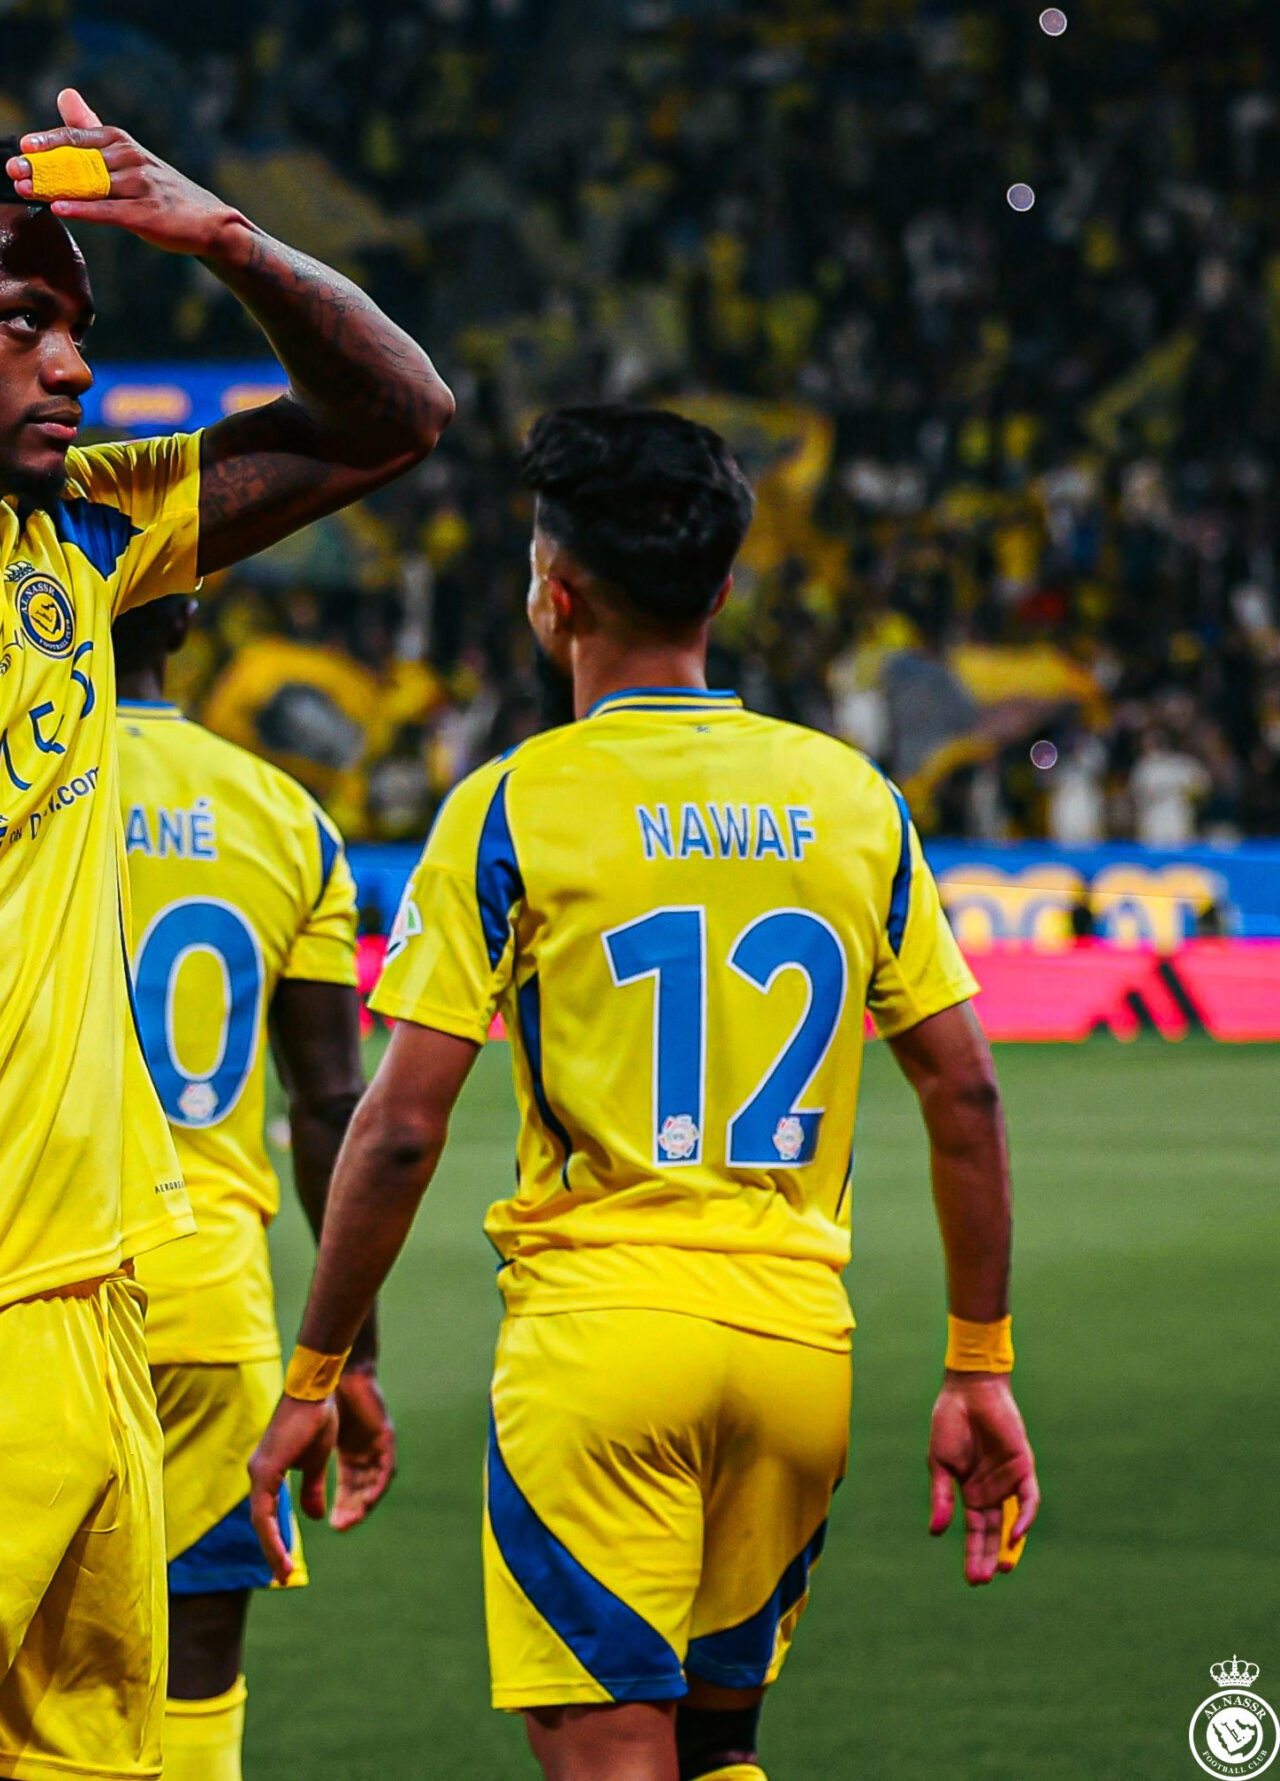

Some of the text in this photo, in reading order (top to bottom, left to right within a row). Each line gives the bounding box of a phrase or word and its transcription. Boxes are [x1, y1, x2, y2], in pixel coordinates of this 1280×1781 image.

[126, 798, 217, 859] ANÉ
[637, 803, 816, 861] NAWAF
[133, 895, 264, 1128] 0
[602, 905, 848, 1169] 12
